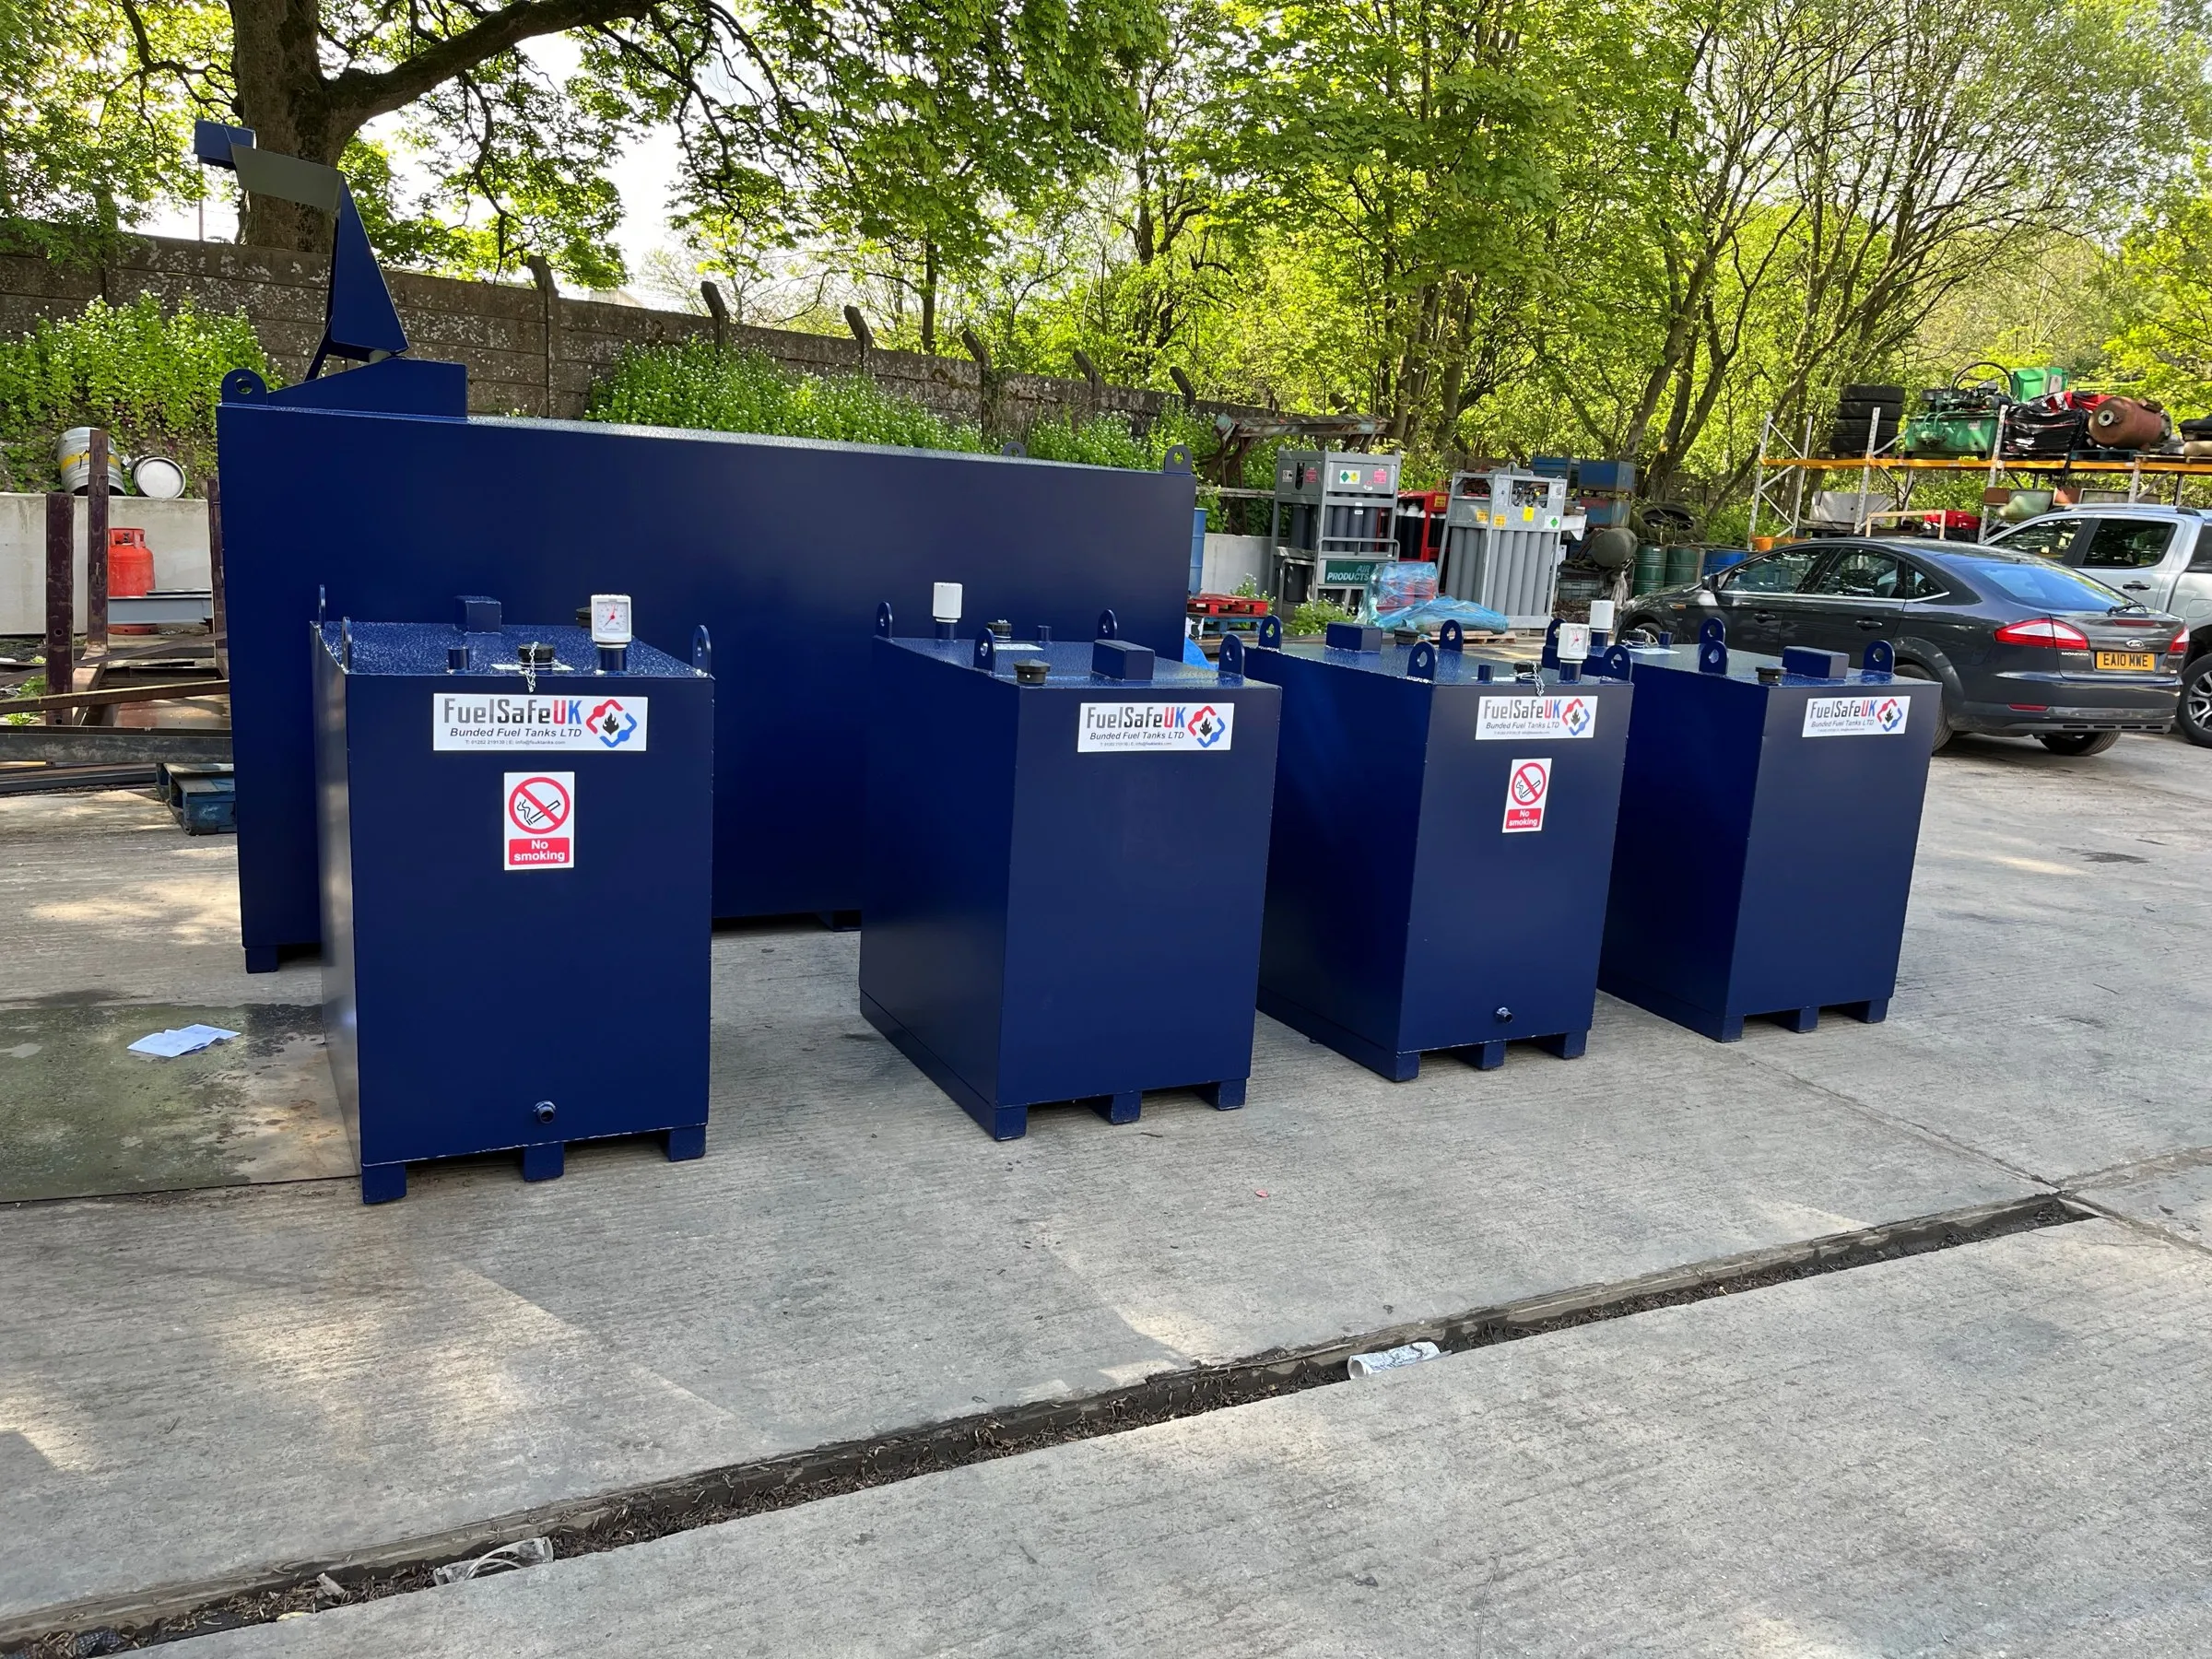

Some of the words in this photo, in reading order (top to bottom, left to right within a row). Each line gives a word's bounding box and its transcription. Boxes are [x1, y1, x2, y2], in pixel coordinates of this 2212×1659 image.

[1327, 572, 1370, 581] PRODUCTS
[450, 727, 494, 737] Bunded
[497, 728, 521, 737] Fuel
[524, 728, 557, 737] Tanks
[559, 729, 582, 737] LTD
[1089, 732, 1121, 740] Bunded
[1123, 732, 1140, 740] Fuel
[1168, 731, 1184, 739] LTD
[1519, 809, 1531, 818] No
[1508, 818, 1538, 827] smoking
[531, 840, 549, 850] No
[513, 851, 566, 862] smoking
